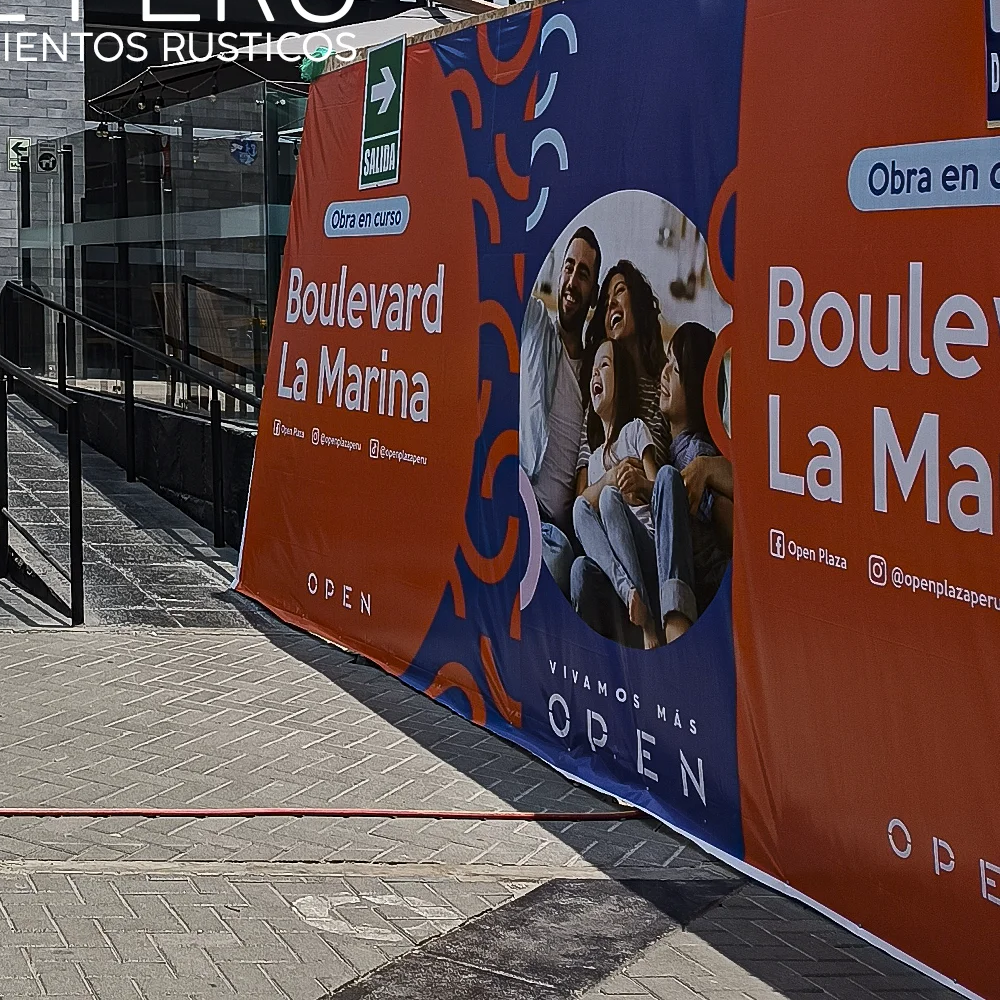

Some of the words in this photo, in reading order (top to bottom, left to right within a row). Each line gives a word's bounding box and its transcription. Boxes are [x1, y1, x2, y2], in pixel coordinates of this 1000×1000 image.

[363, 142, 396, 177] SALIDA
[868, 160, 932, 196] Obra
[941, 163, 979, 192] en
[331, 210, 356, 229] Obra
[358, 212, 371, 228] en
[374, 209, 402, 227] curso
[285, 263, 445, 334] Boulevard
[277, 341, 308, 402] La
[317, 345, 430, 423] Marina
[320, 433, 362, 451] @openplazaperu
[380, 445, 428, 465] @openplazaperu
[768, 394, 843, 504] La
[788, 540, 816, 561] Open
[818, 547, 848, 570] Plaza
[307, 572, 373, 616] OPEN
[891, 566, 1000, 611] @openplazaperu
[549, 660, 640, 709] VIVAMOS
[657, 708, 698, 735] MÁS
[548, 693, 708, 807] OPEN
